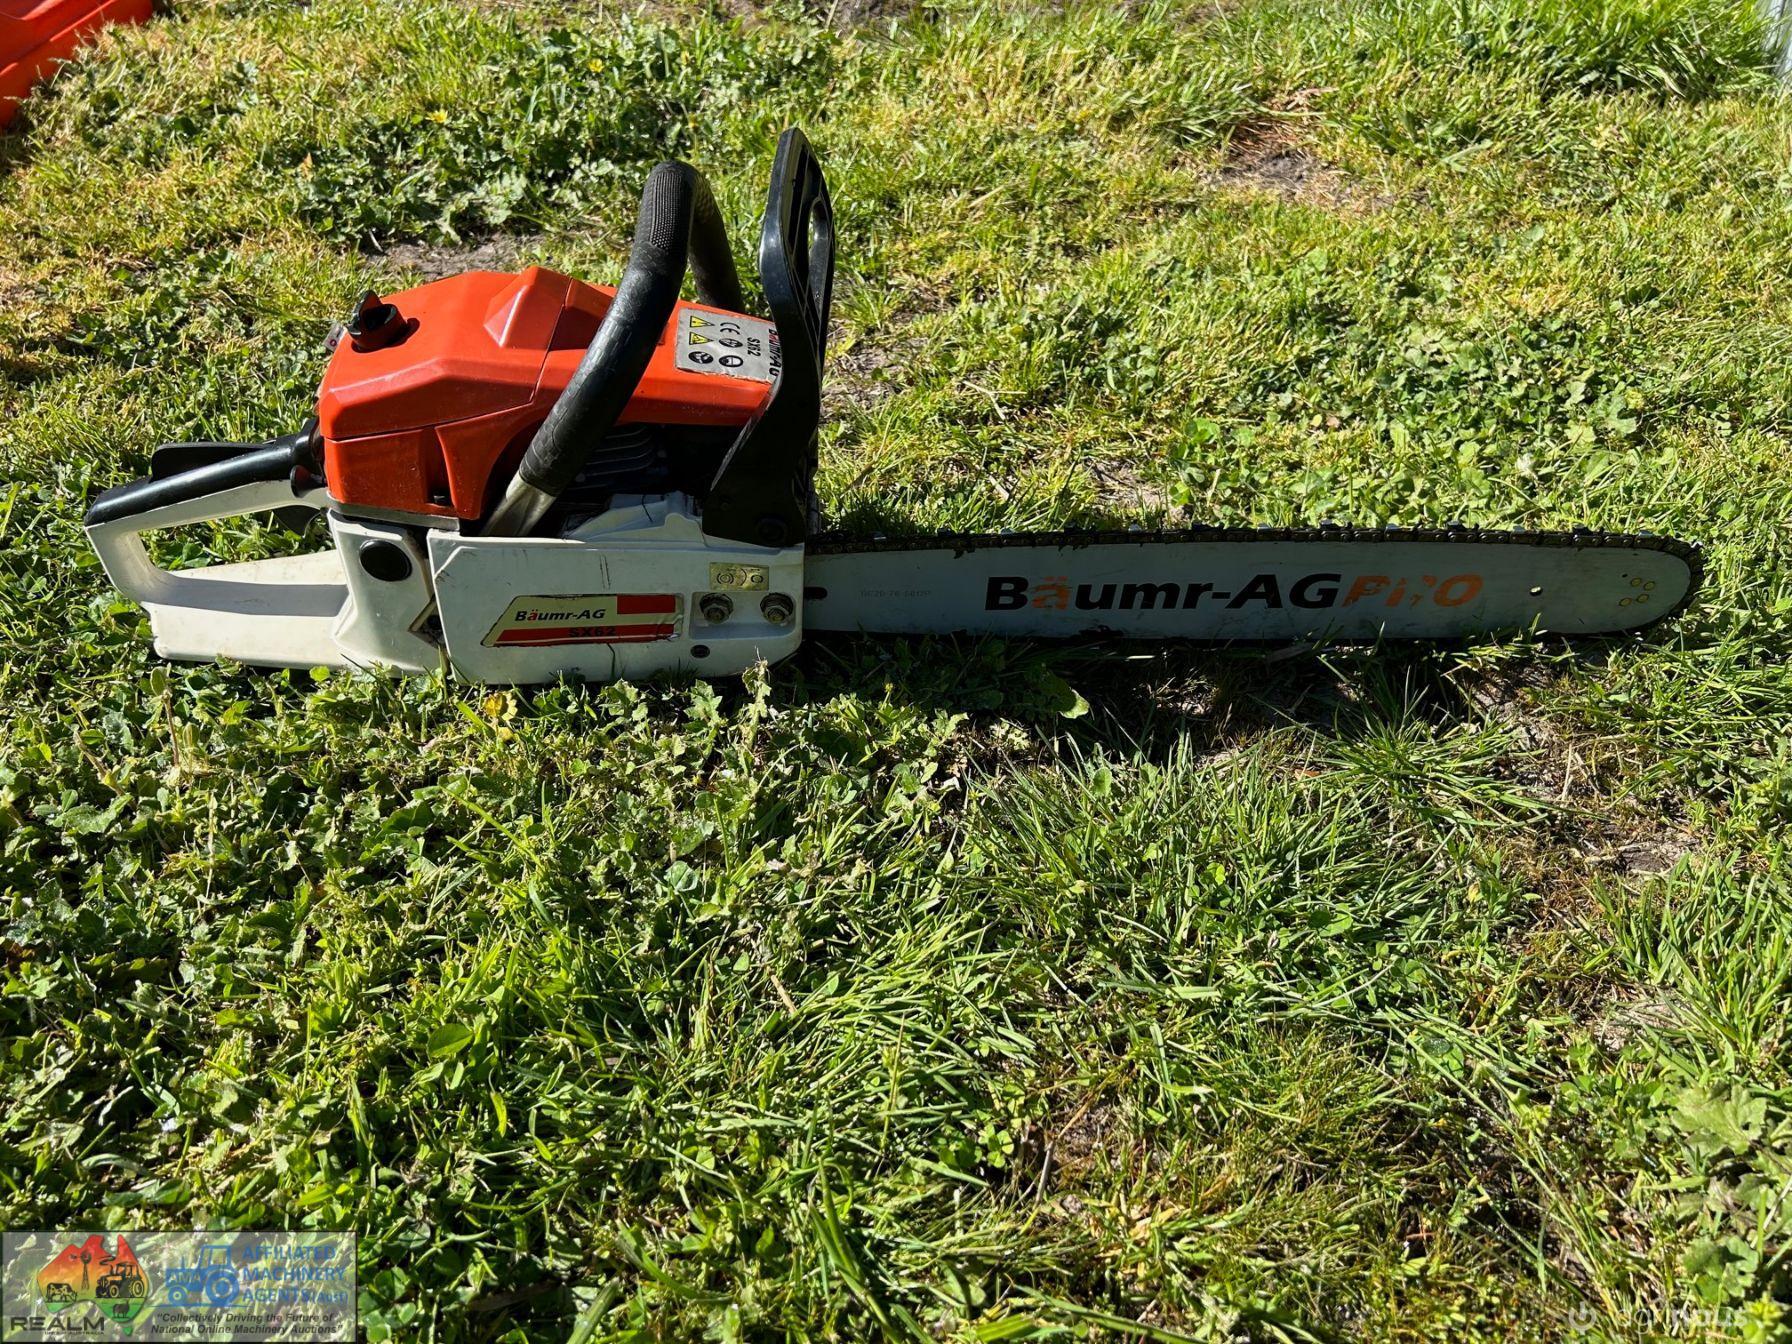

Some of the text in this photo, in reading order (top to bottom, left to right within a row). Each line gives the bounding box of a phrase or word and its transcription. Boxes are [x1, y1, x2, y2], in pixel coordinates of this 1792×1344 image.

[747, 337, 761, 357] SX62
[514, 608, 606, 622] Bäumr-AG
[568, 626, 617, 638] SX62
